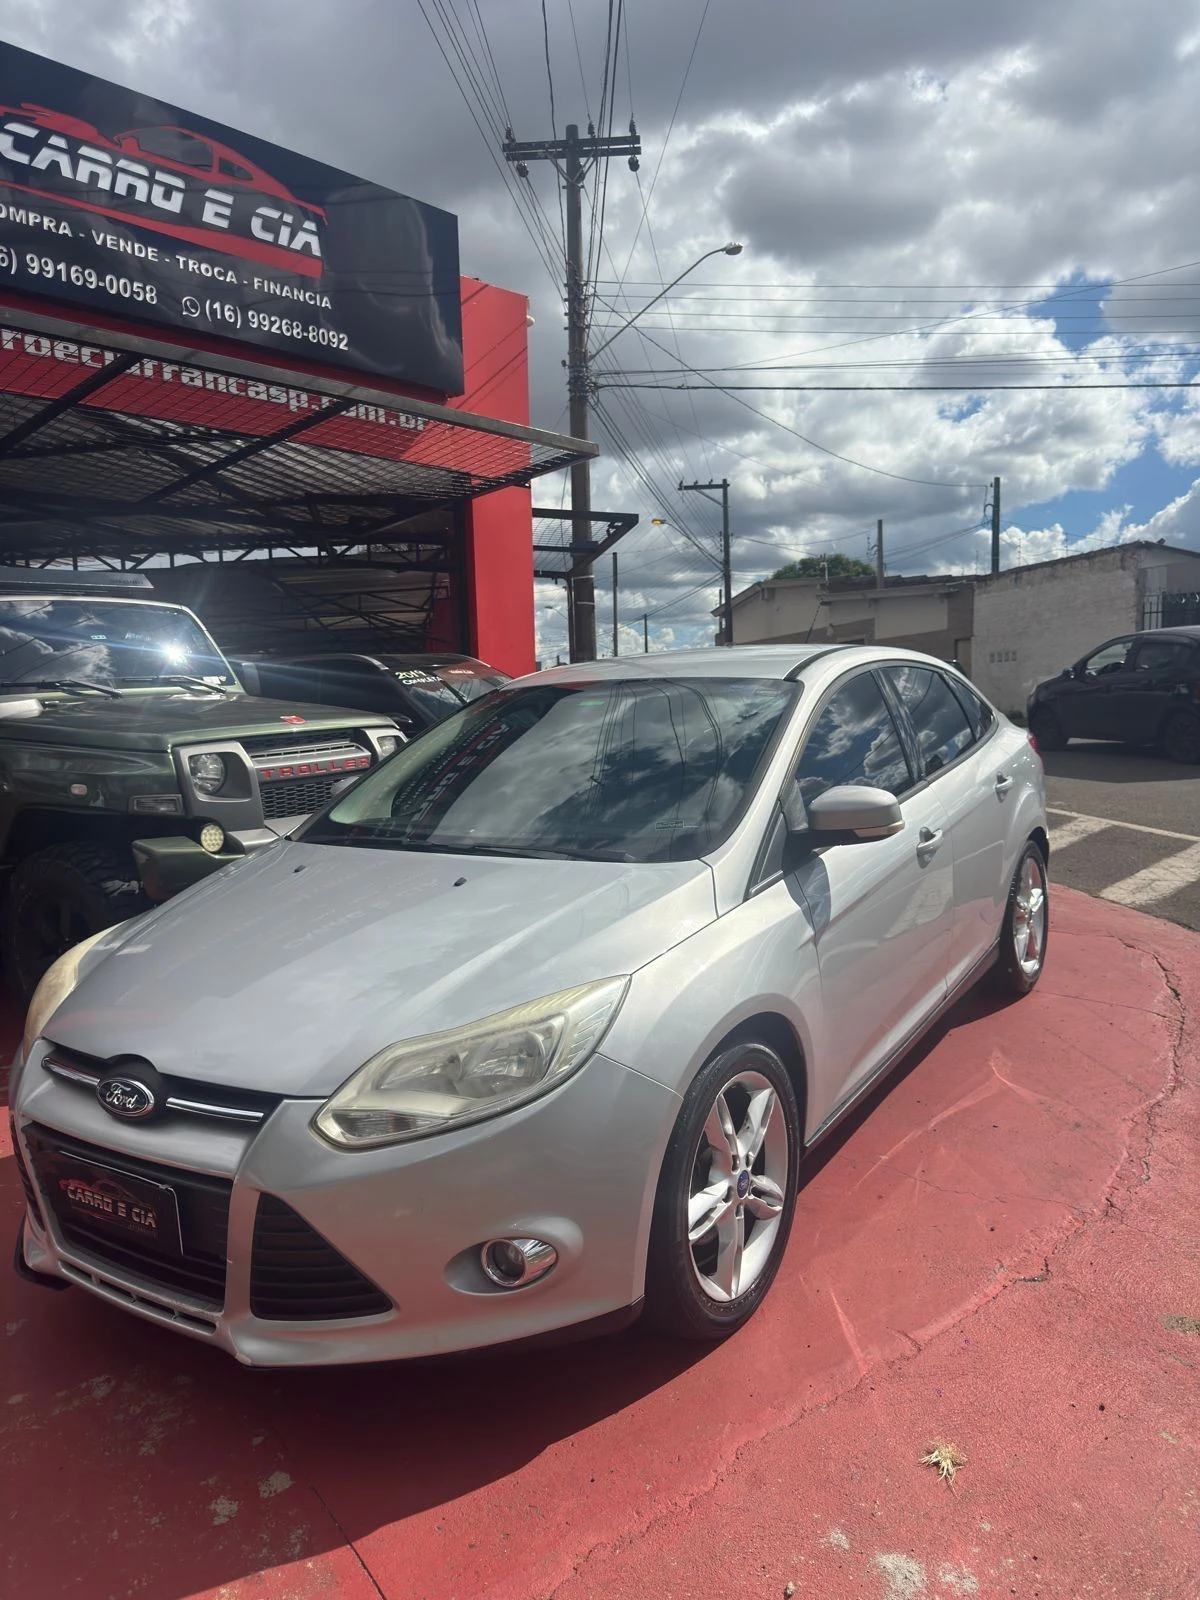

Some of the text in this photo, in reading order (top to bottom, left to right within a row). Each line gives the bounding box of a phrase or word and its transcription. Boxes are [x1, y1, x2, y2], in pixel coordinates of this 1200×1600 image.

[0, 123, 322, 257] CARRO E CIA
[92, 230, 159, 261] VENDE
[175, 255, 238, 284] TROCA
[253, 277, 332, 309] FINANCIA
[26, 253, 158, 304] 99169-0058
[205, 299, 241, 328] (16)
[248, 310, 349, 350] 99268-8092
[260, 758, 369, 780] TROLLER
[106, 1083, 138, 1108] Ford
[67, 1186, 112, 1213] CARRO
[118, 1201, 126, 1217] E
